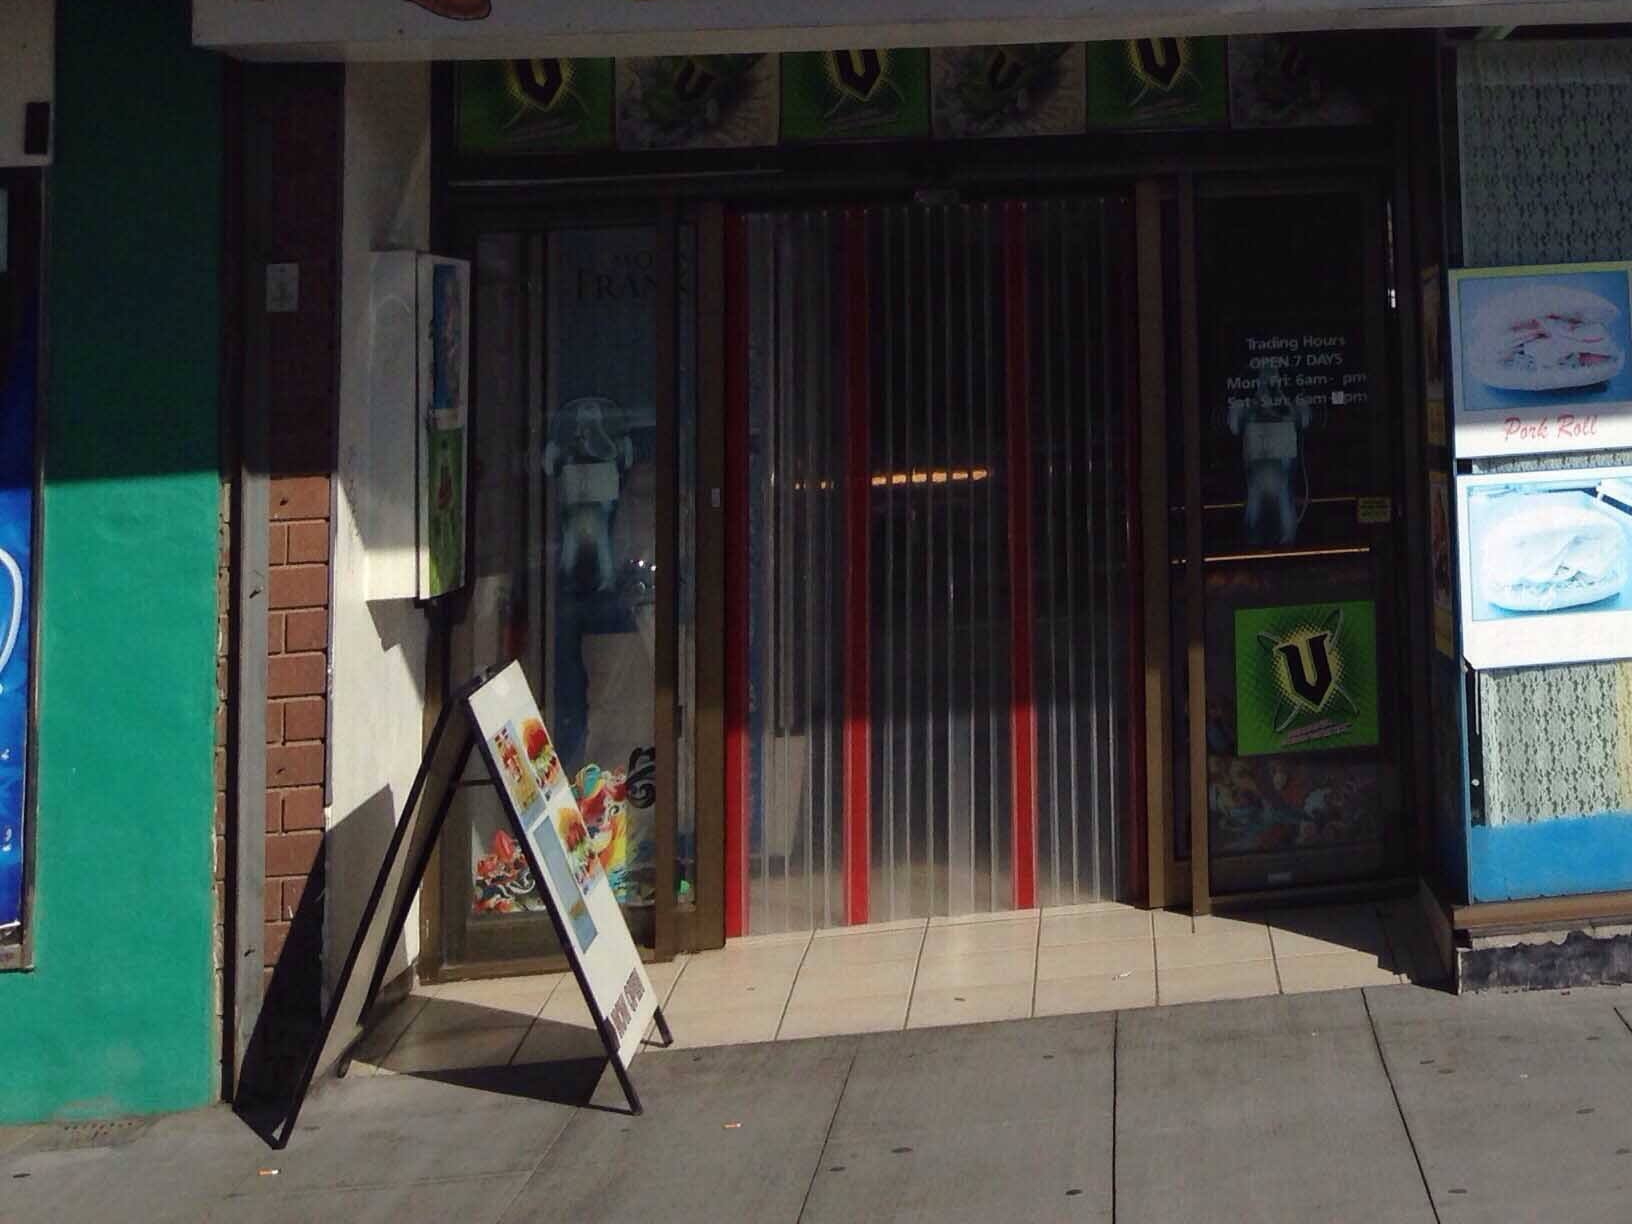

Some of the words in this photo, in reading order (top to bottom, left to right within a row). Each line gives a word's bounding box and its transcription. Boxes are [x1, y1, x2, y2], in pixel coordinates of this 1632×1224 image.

[1245, 337, 1299, 352] Trading
[1303, 335, 1347, 348] Hours
[1306, 352, 1344, 367] DAYS
[1503, 416, 1549, 441] Pork
[1556, 414, 1598, 439] Roll
